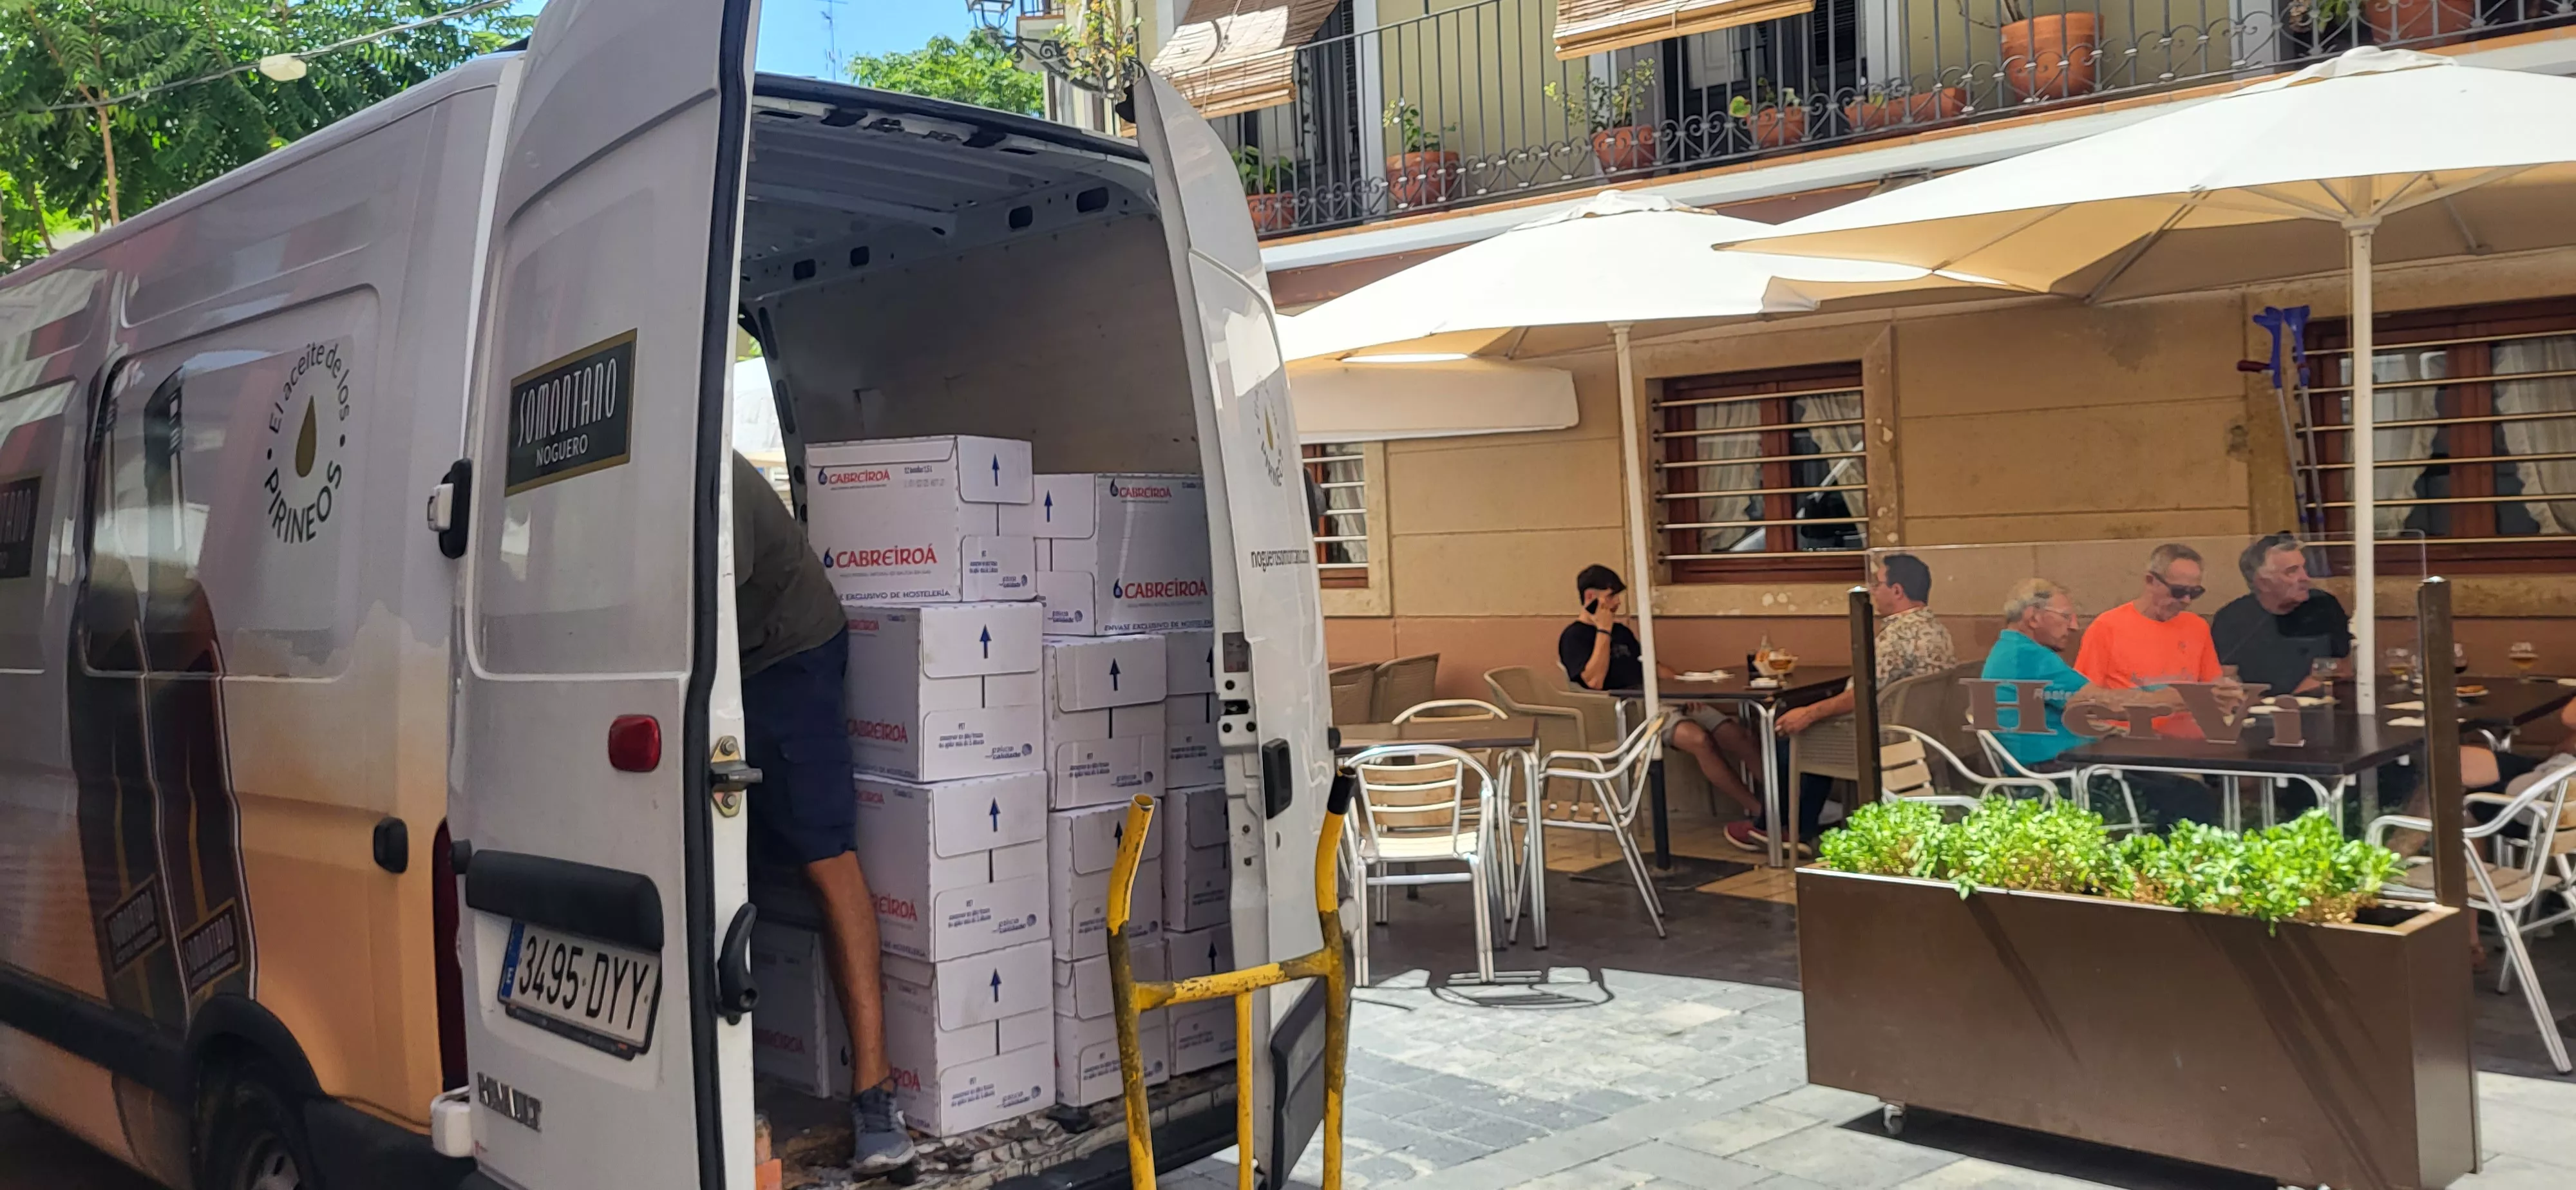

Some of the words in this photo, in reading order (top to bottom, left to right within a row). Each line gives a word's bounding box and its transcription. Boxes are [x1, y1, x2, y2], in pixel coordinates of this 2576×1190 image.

[283, 342, 325, 401] aceite
[325, 343, 342, 379] de
[337, 368, 350, 422] los
[518, 357, 617, 448] SOMONTANO
[536, 434, 589, 461] NOGUERO
[265, 460, 343, 544] PIRINEOS
[519, 934, 584, 1011] 3495
[585, 950, 649, 1030] DYY
